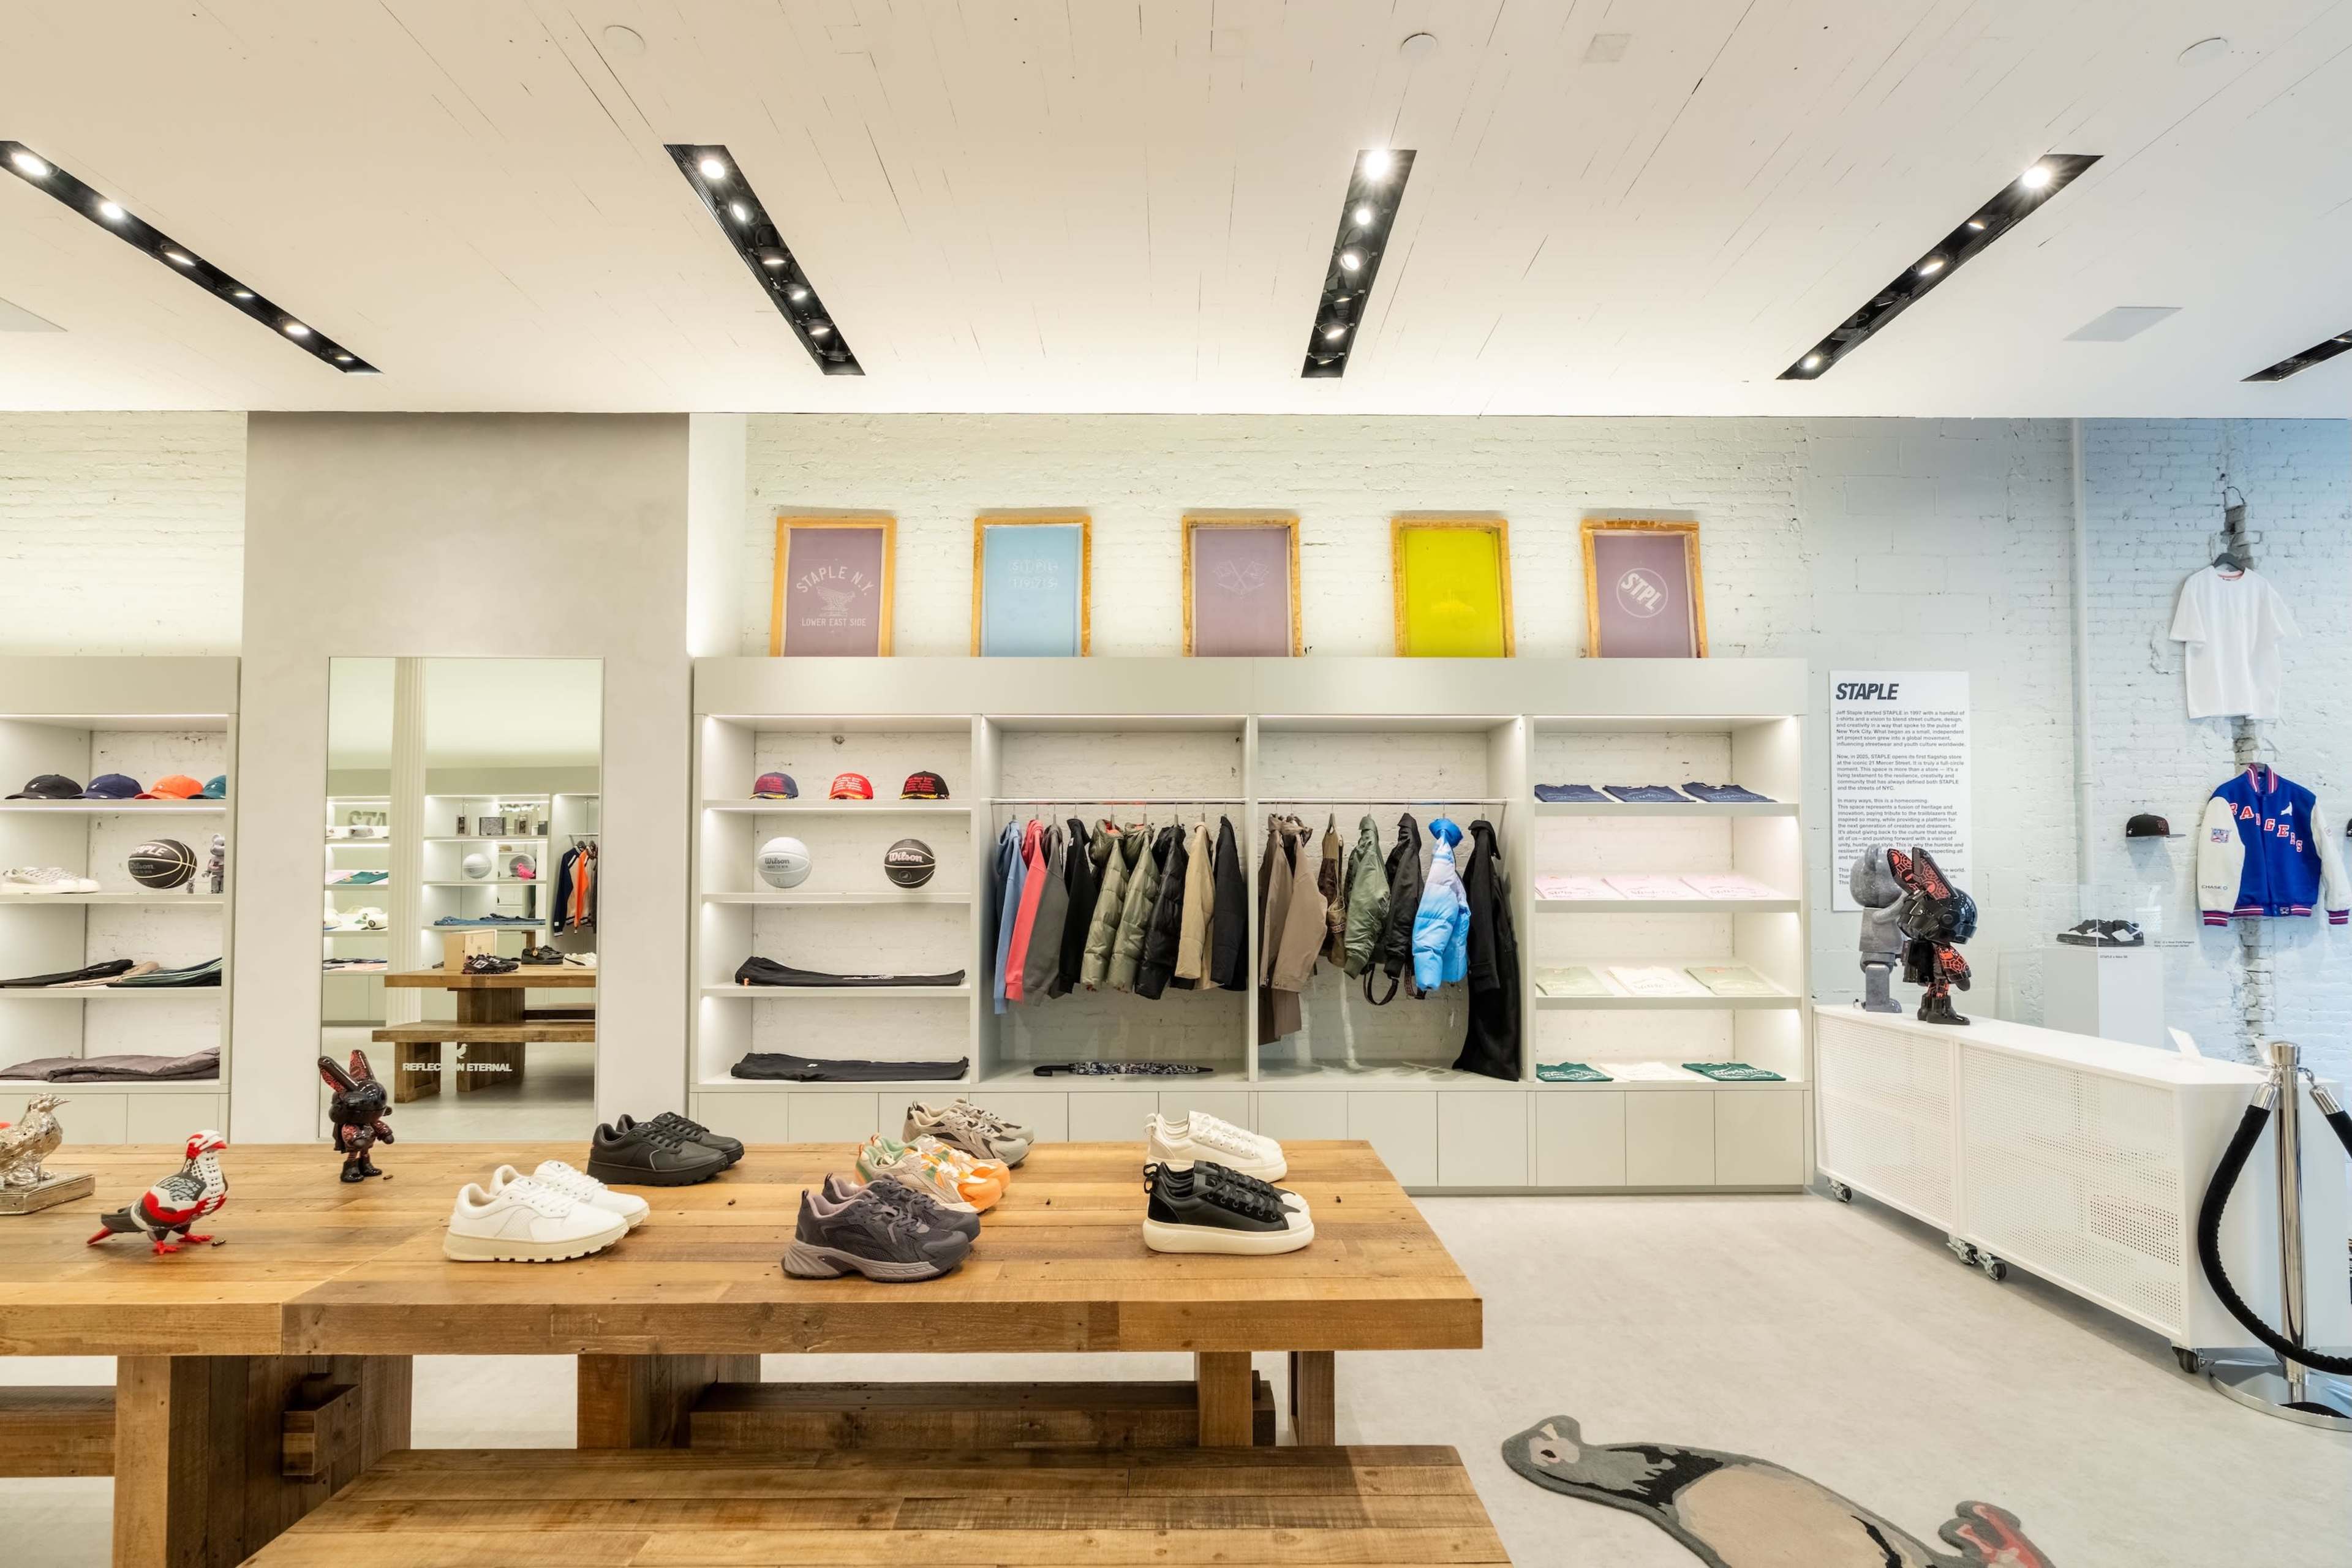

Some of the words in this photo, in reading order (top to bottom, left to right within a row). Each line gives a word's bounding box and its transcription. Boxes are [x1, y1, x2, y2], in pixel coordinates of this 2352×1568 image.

[796, 565, 848, 593] STAPLE
[851, 571, 875, 596] N.Y.
[1620, 573, 1662, 612] STPL
[802, 618, 826, 627] LOWER
[829, 618, 846, 627] EAST
[850, 618, 866, 627] SIDE
[1836, 682, 1899, 700] STAPLE
[889, 851, 924, 862] Wilson
[402, 1063, 465, 1071] REFLECN
[466, 1063, 513, 1071] ETERNAL
